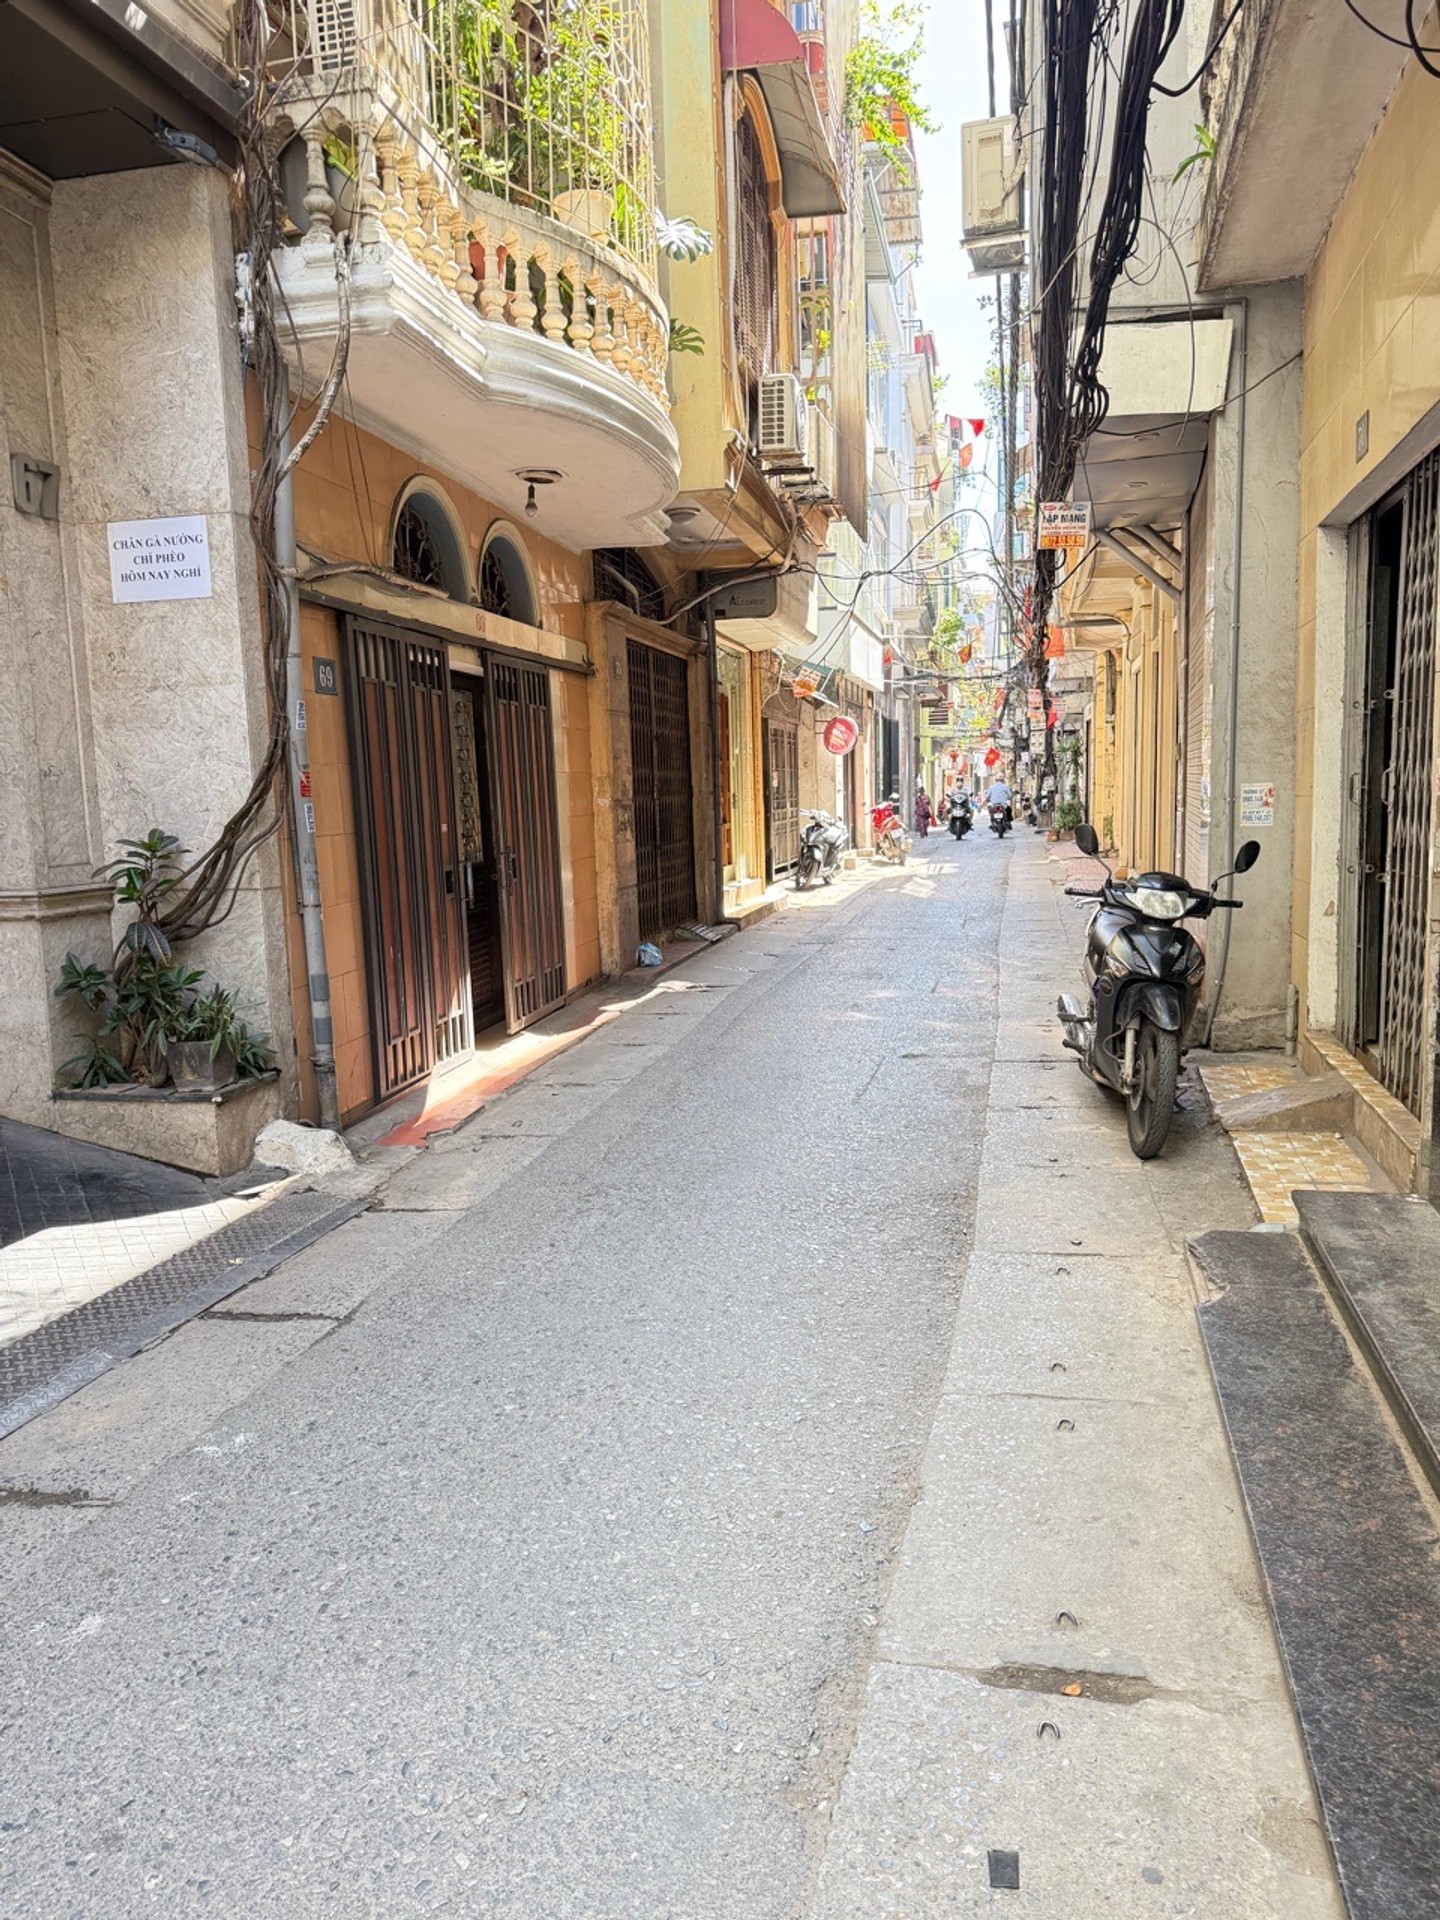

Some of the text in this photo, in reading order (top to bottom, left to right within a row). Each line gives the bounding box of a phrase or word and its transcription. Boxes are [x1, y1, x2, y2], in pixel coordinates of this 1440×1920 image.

[10, 453, 61, 520] 67
[113, 536, 143, 551] CHÂN
[145, 534, 162, 548] GÀ
[121, 570, 146, 583] HÔM
[148, 570, 171, 581] NAY
[319, 665, 333, 688] 69
